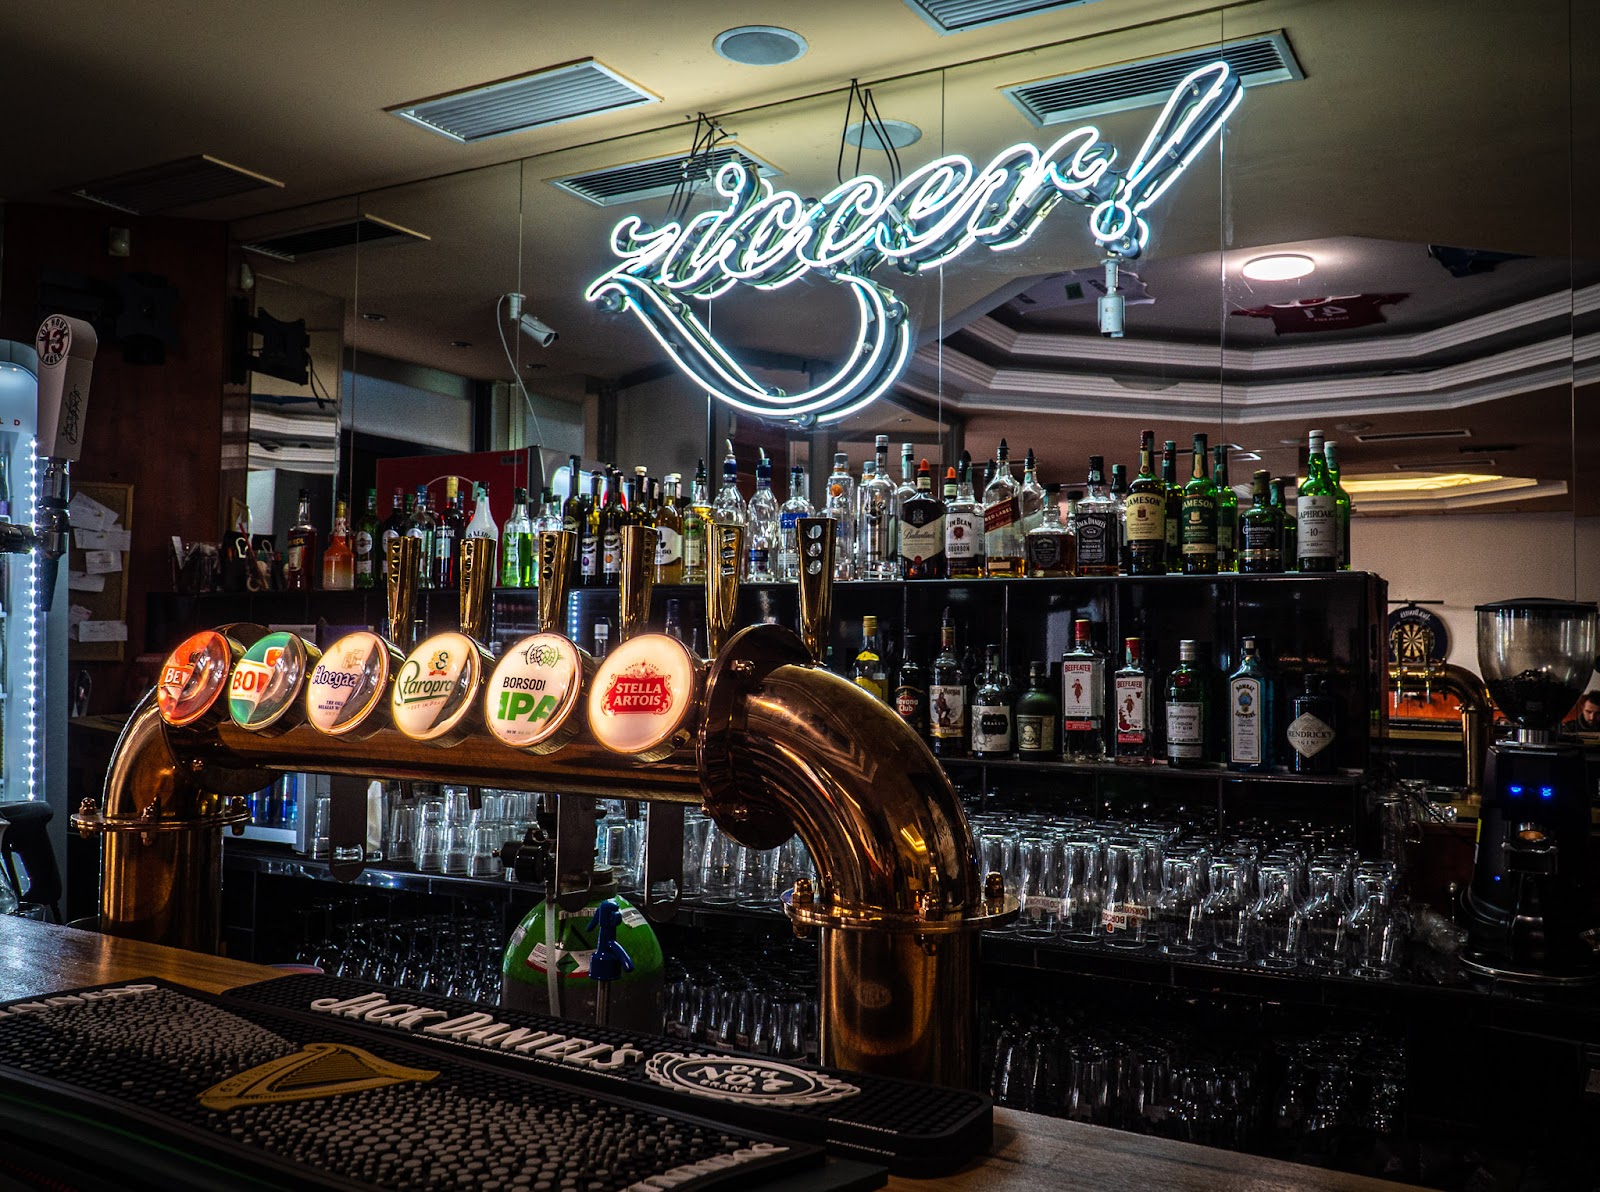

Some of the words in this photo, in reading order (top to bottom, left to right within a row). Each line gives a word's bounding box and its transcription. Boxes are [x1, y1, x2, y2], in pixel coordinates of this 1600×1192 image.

[44, 329, 64, 354] 13
[1127, 496, 1161, 508] JAMESON
[956, 517, 972, 529] BEAM
[1310, 528, 1318, 536] 10
[1065, 664, 1091, 672] BEEFEATER
[503, 677, 546, 691] BORSODI
[615, 683, 662, 694] STELLA
[1117, 680, 1142, 688] BEEFEATER
[613, 695, 661, 706] ARTOIS
[498, 691, 558, 722] IPA
[899, 704, 913, 712] Club
[309, 991, 448, 1031] JACK
